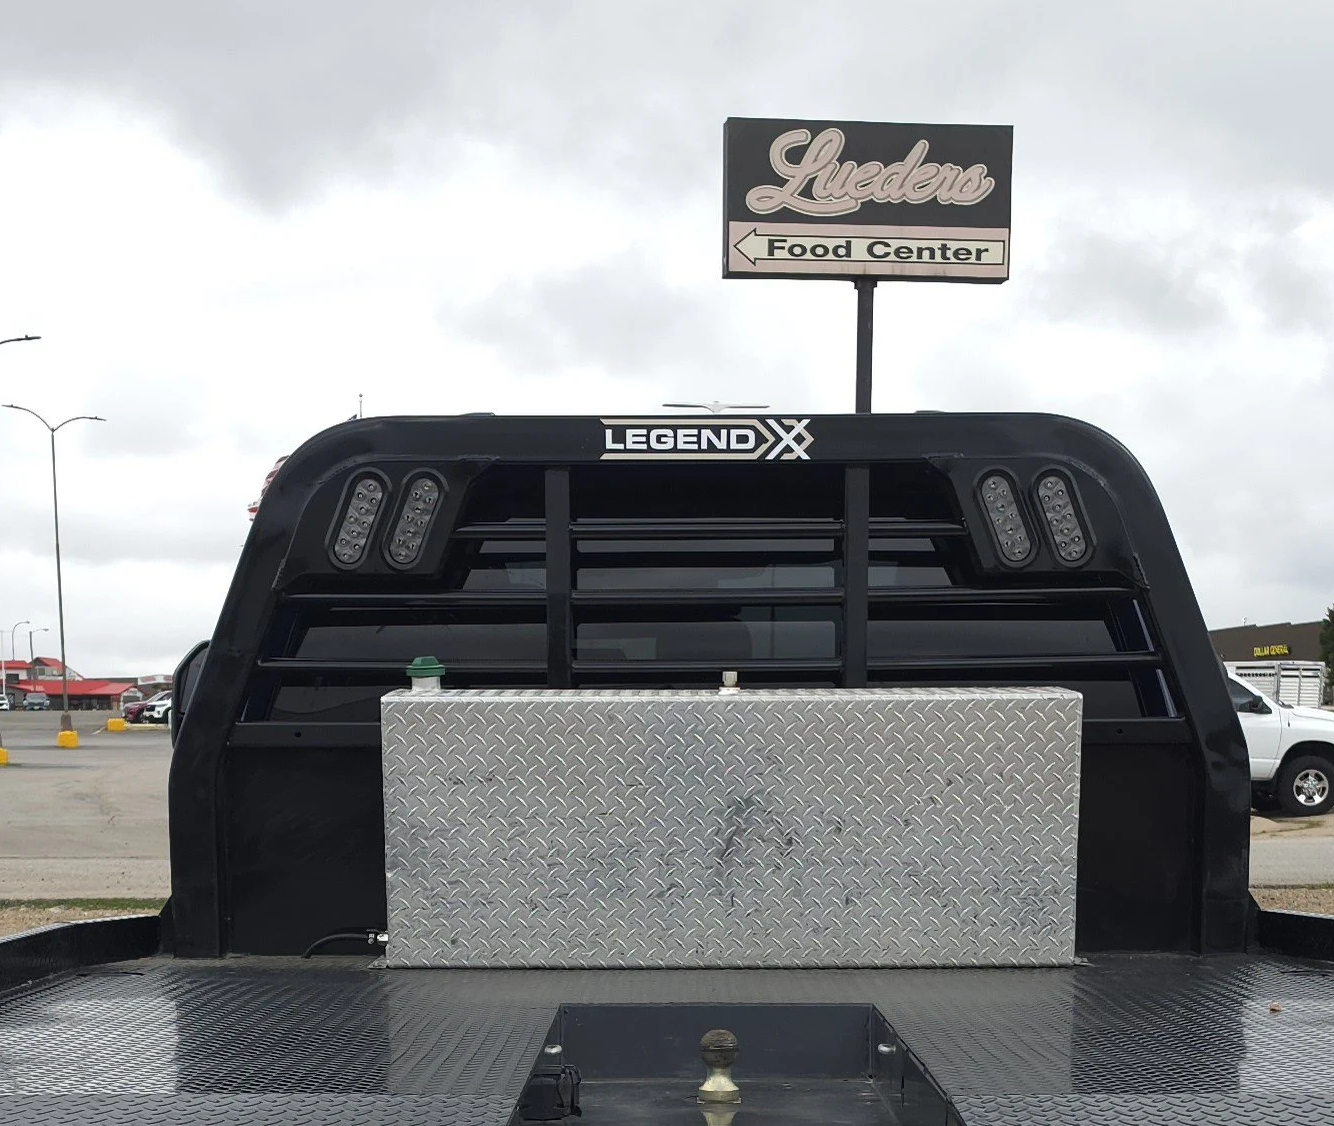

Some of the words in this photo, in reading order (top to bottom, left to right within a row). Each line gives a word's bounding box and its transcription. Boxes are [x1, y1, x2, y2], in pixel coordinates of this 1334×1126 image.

[746, 128, 995, 217] Lueders
[767, 238, 852, 259] Food
[866, 240, 989, 262] Center
